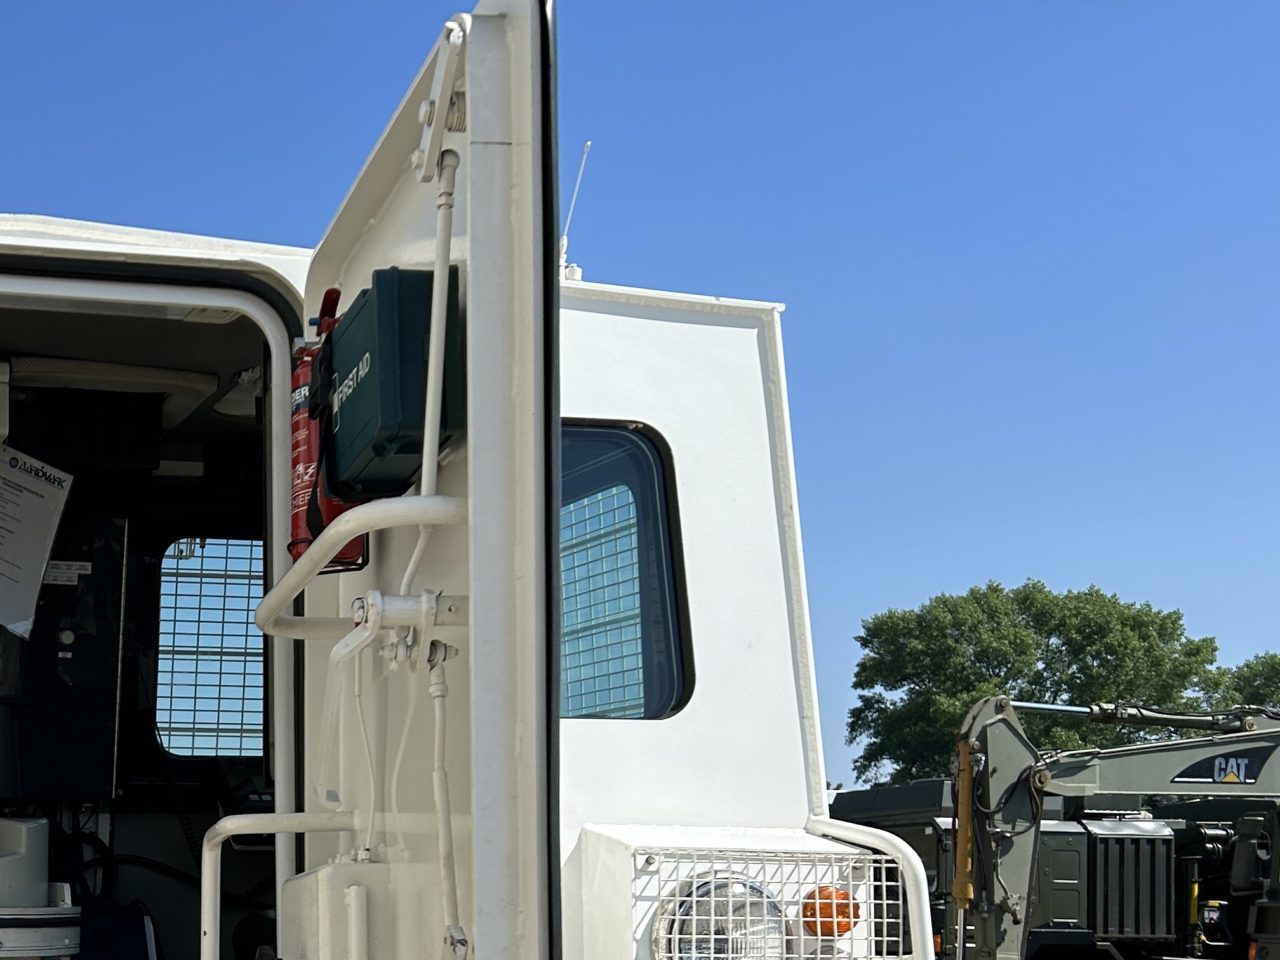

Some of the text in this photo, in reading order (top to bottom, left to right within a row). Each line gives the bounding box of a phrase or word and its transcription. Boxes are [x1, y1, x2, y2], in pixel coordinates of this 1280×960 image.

[336, 351, 371, 407] FIRST AID
[1214, 757, 1249, 783] CAT
